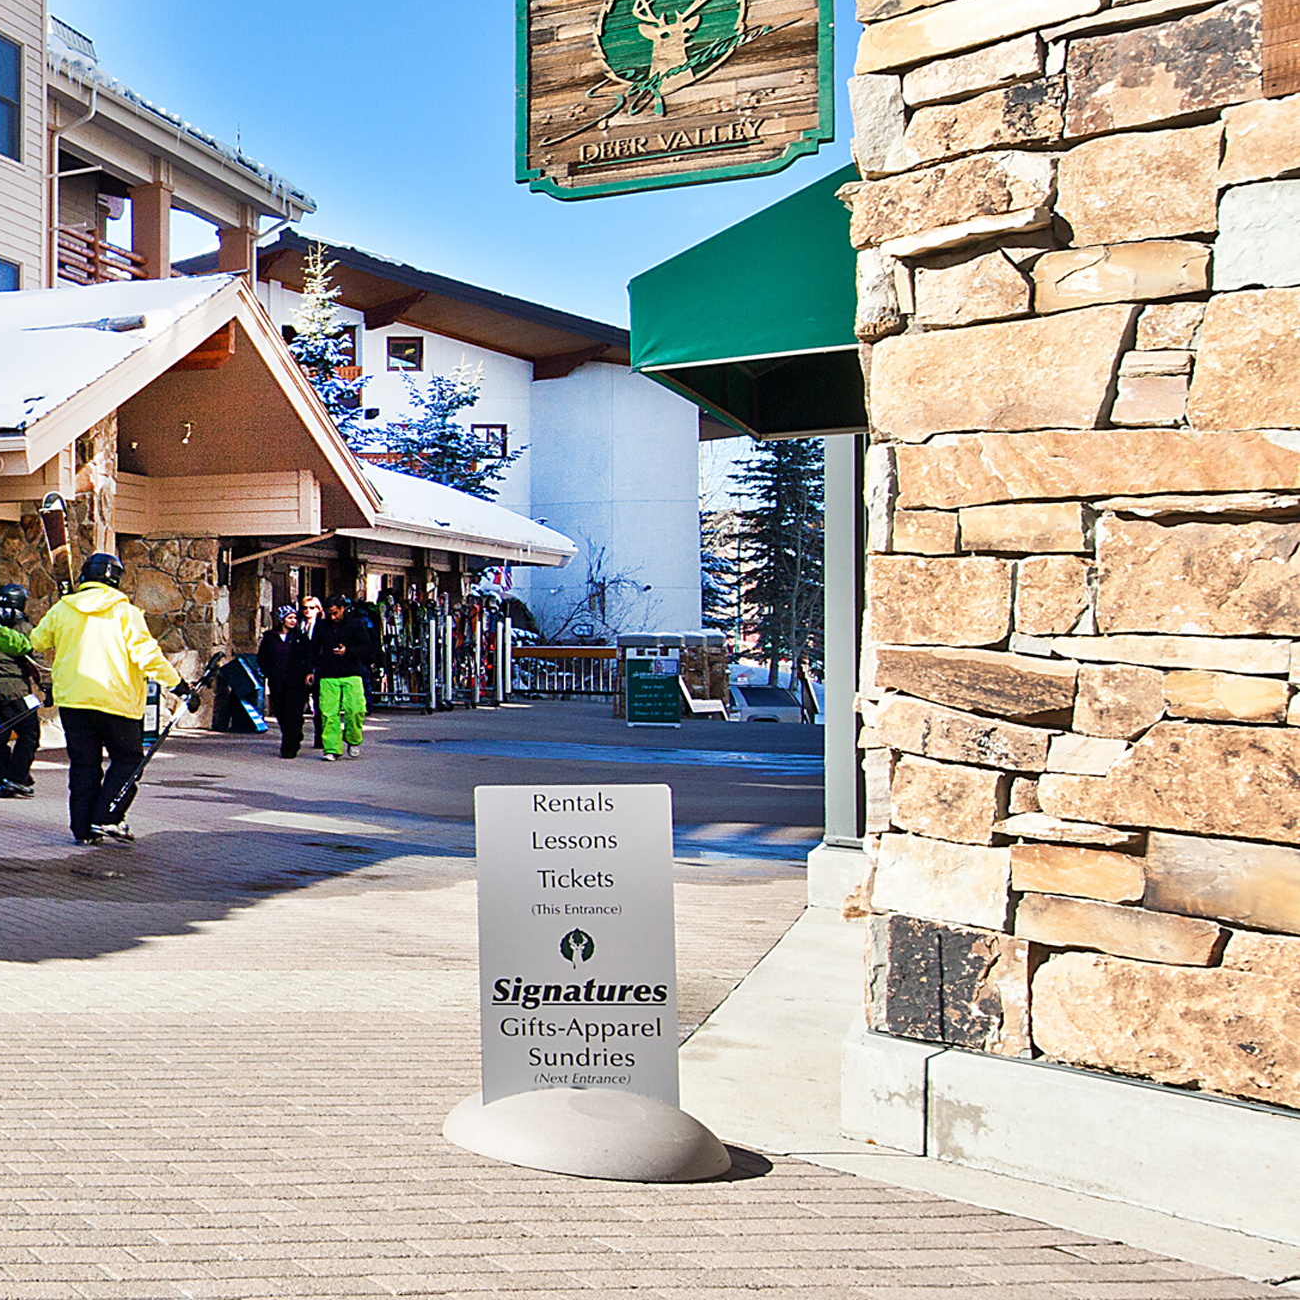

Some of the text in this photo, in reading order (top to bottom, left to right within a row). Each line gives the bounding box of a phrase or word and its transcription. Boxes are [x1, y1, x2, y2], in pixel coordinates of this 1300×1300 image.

[579, 119, 766, 164] DEER VALLEY
[533, 792, 615, 812] Rentals
[532, 831, 618, 850] Lessons
[537, 868, 615, 889] Tickets
[531, 904, 623, 916] (This Entrance)
[492, 976, 668, 1010] Signatures
[500, 1016, 662, 1043] Gifts-Apparel
[528, 1047, 636, 1068] Sundries
[533, 1073, 632, 1085] (Next Entrance)
